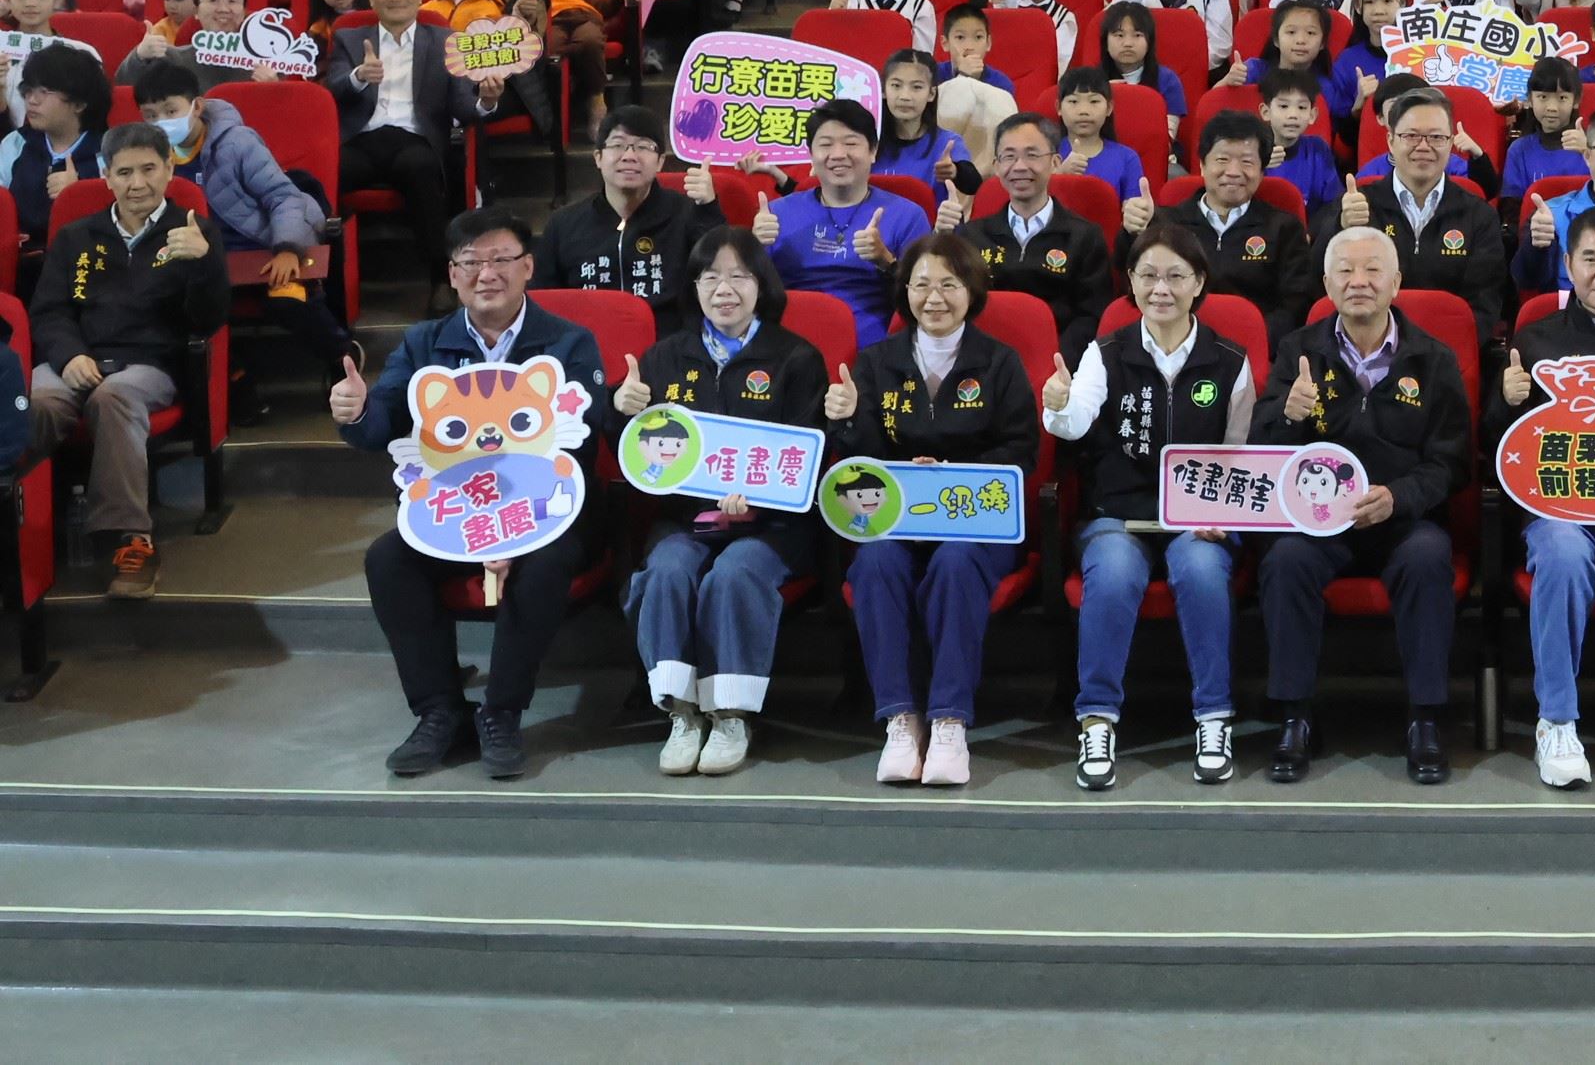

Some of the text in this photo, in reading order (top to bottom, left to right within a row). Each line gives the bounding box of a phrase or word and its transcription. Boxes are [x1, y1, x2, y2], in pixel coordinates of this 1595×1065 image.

[194, 32, 241, 52] CISH
[456, 28, 524, 52] 君毅中學
[1400, 7, 1560, 58] 南庄國小
[198, 53, 254, 68] TOGETHER
[598, 256, 611, 283] 助理
[1138, 386, 1153, 455] 苗栗縣議員
[428, 471, 499, 523] 大家
[908, 479, 1009, 519] 一級棒
